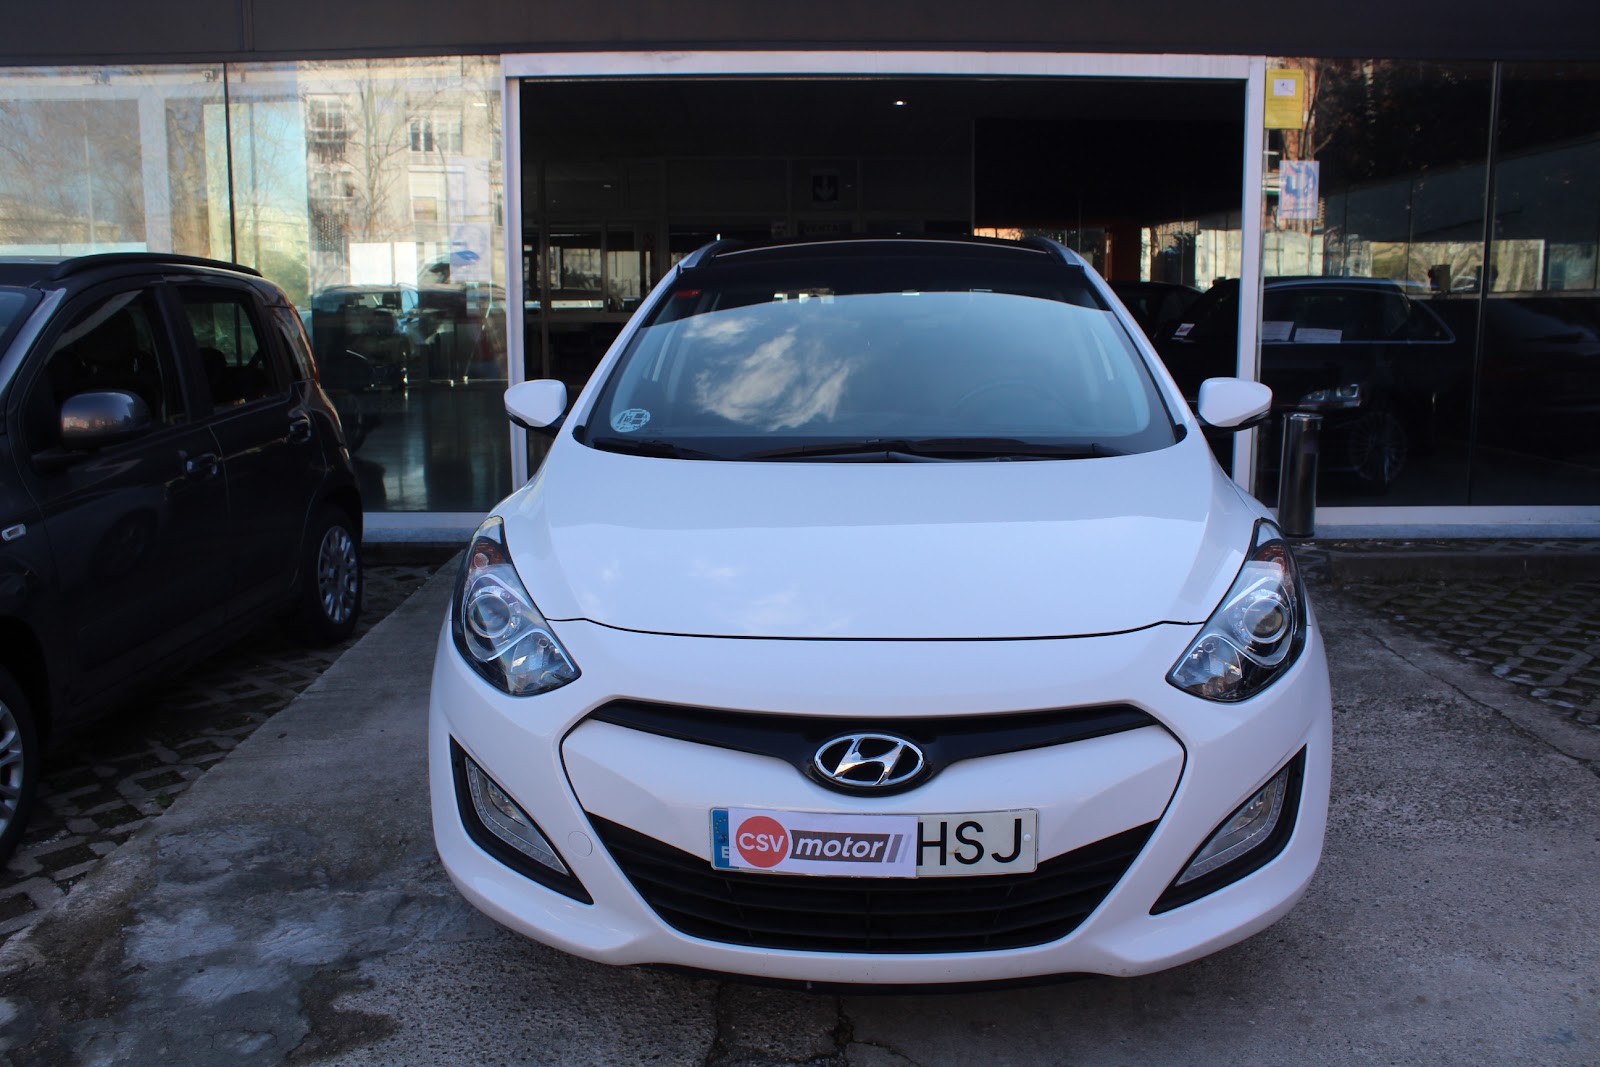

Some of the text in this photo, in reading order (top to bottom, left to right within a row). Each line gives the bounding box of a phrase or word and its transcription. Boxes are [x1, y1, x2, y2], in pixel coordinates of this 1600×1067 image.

[739, 832, 884, 858] CSV motor
[916, 818, 1022, 866] HSJ
